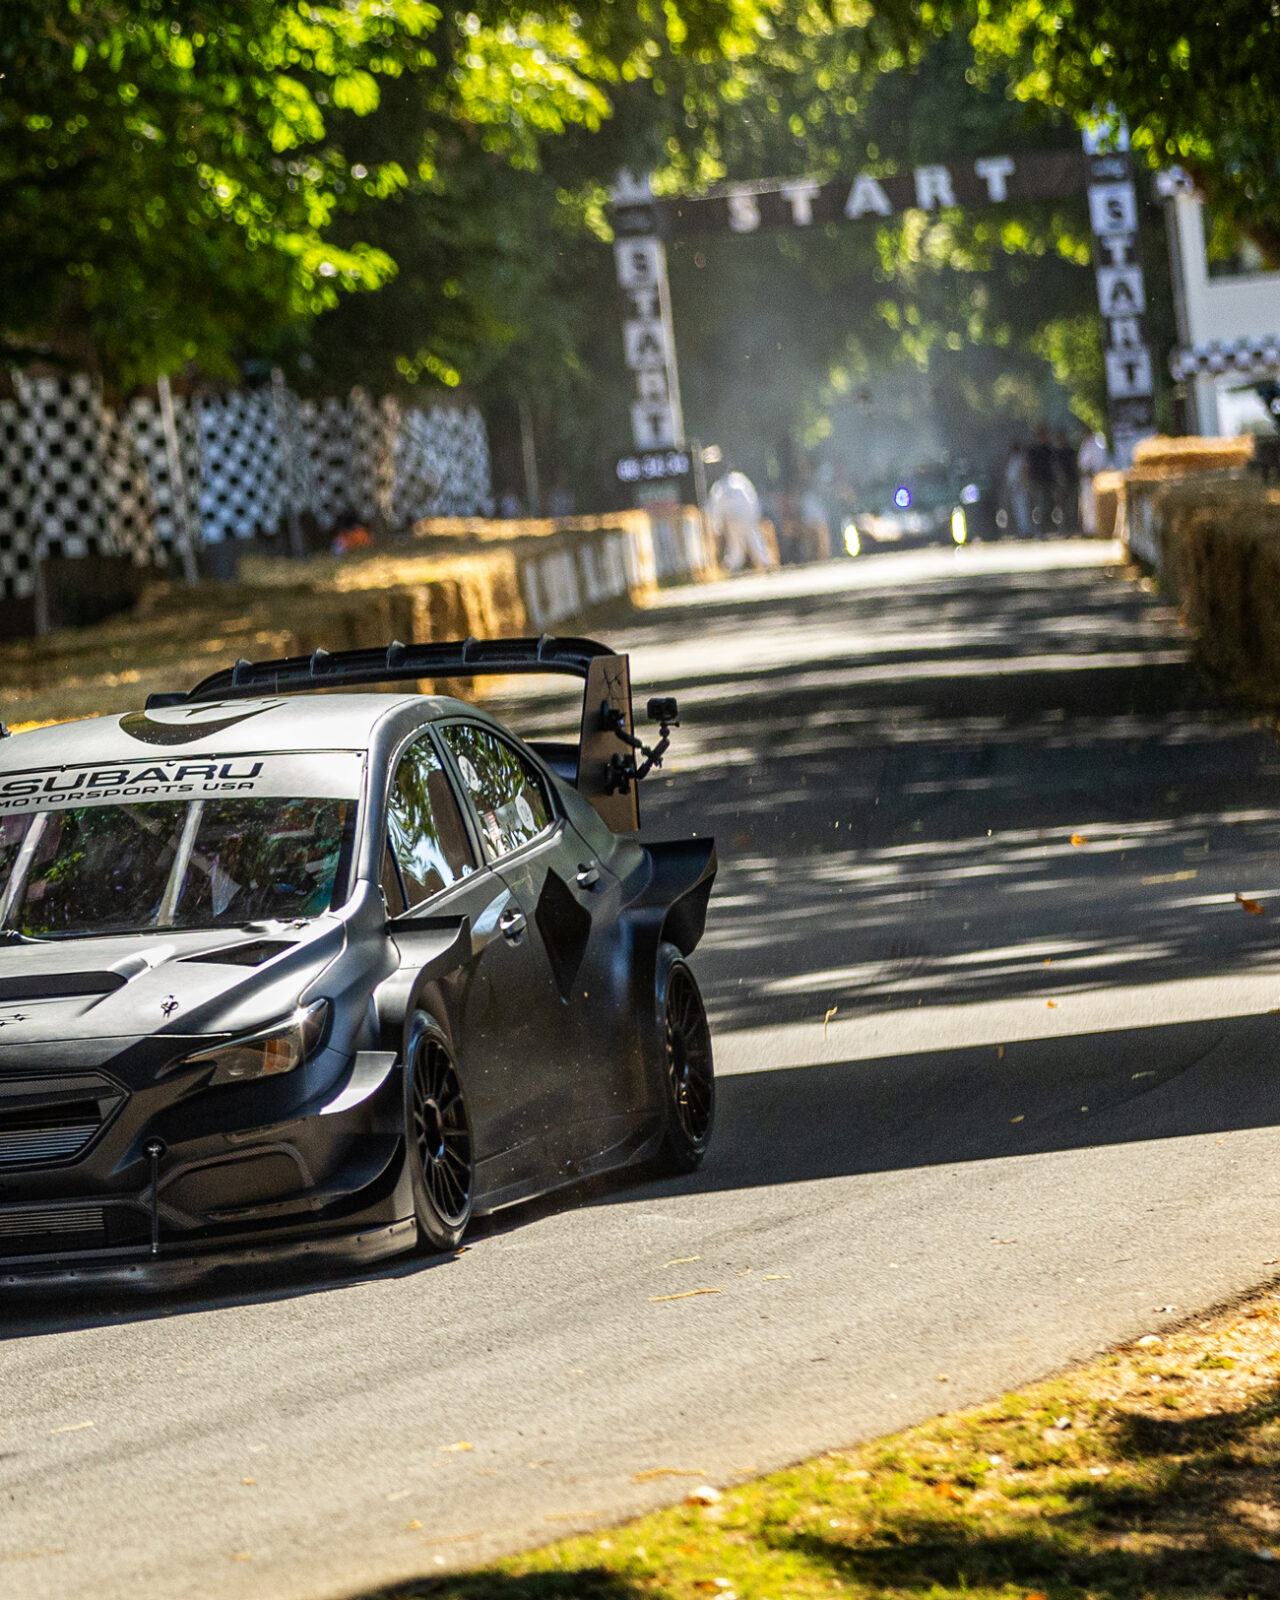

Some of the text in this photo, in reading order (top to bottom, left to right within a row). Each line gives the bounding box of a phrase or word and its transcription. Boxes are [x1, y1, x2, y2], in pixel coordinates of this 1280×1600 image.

[727, 155, 1016, 234] START
[620, 243, 670, 442] START
[1096, 192, 1144, 394] START
[202, 781, 256, 792] USA
